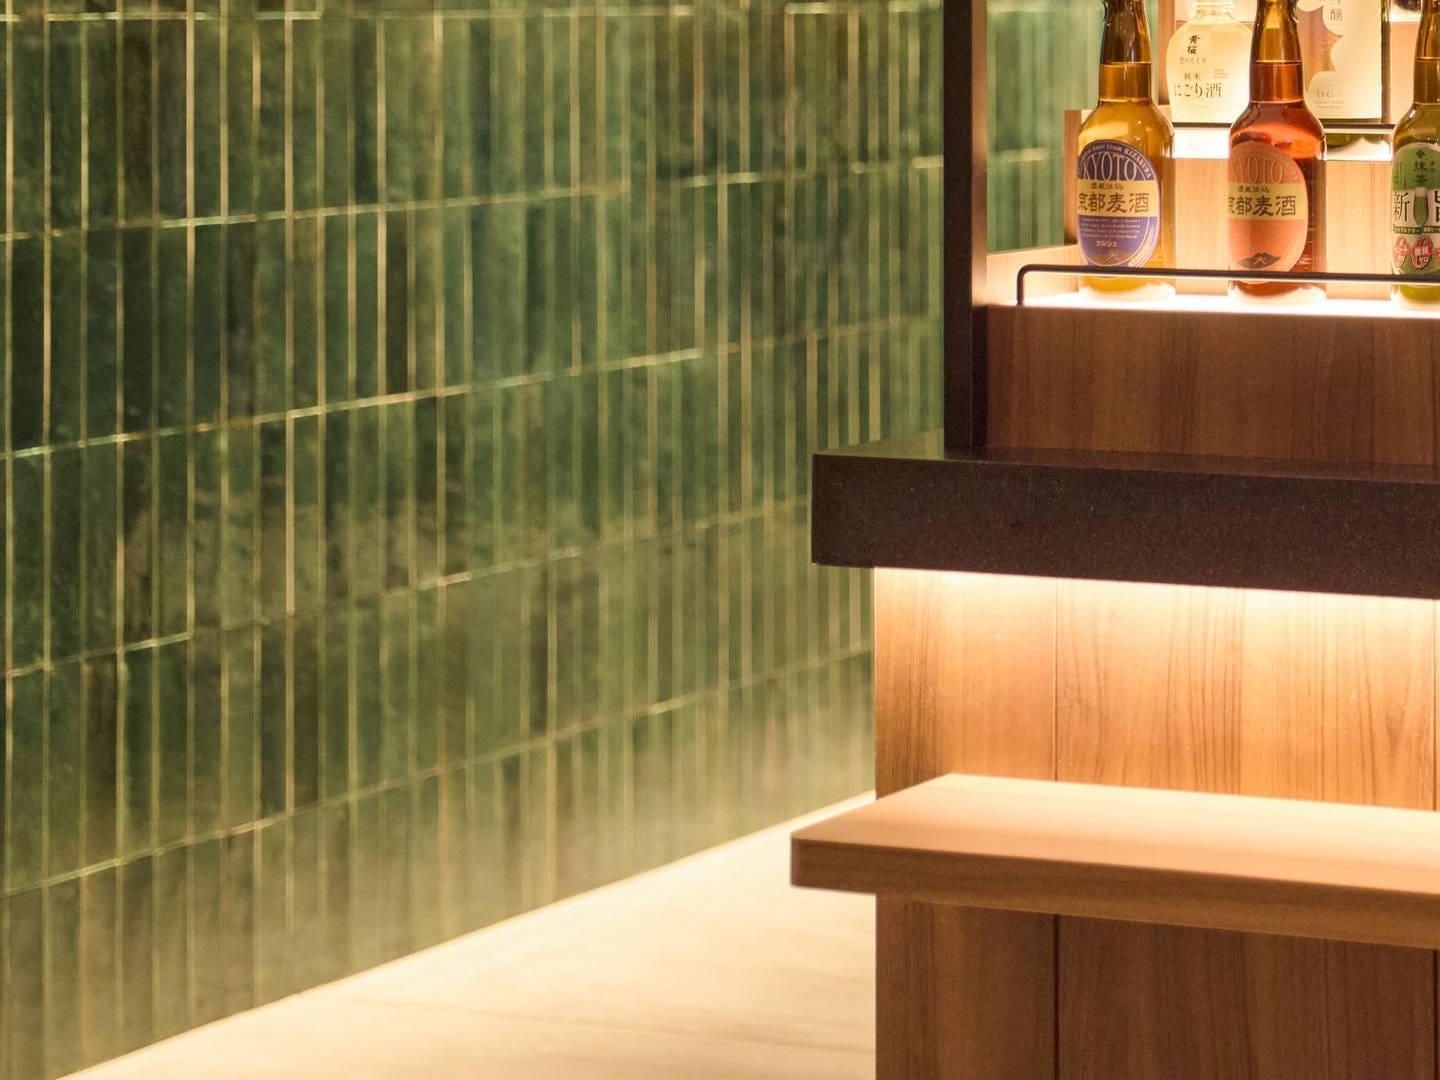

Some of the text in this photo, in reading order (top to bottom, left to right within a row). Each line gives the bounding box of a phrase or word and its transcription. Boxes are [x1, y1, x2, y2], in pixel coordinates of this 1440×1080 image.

[1174, 82, 1222, 99] にごり酒
[1083, 151, 1138, 181] KYOTO
